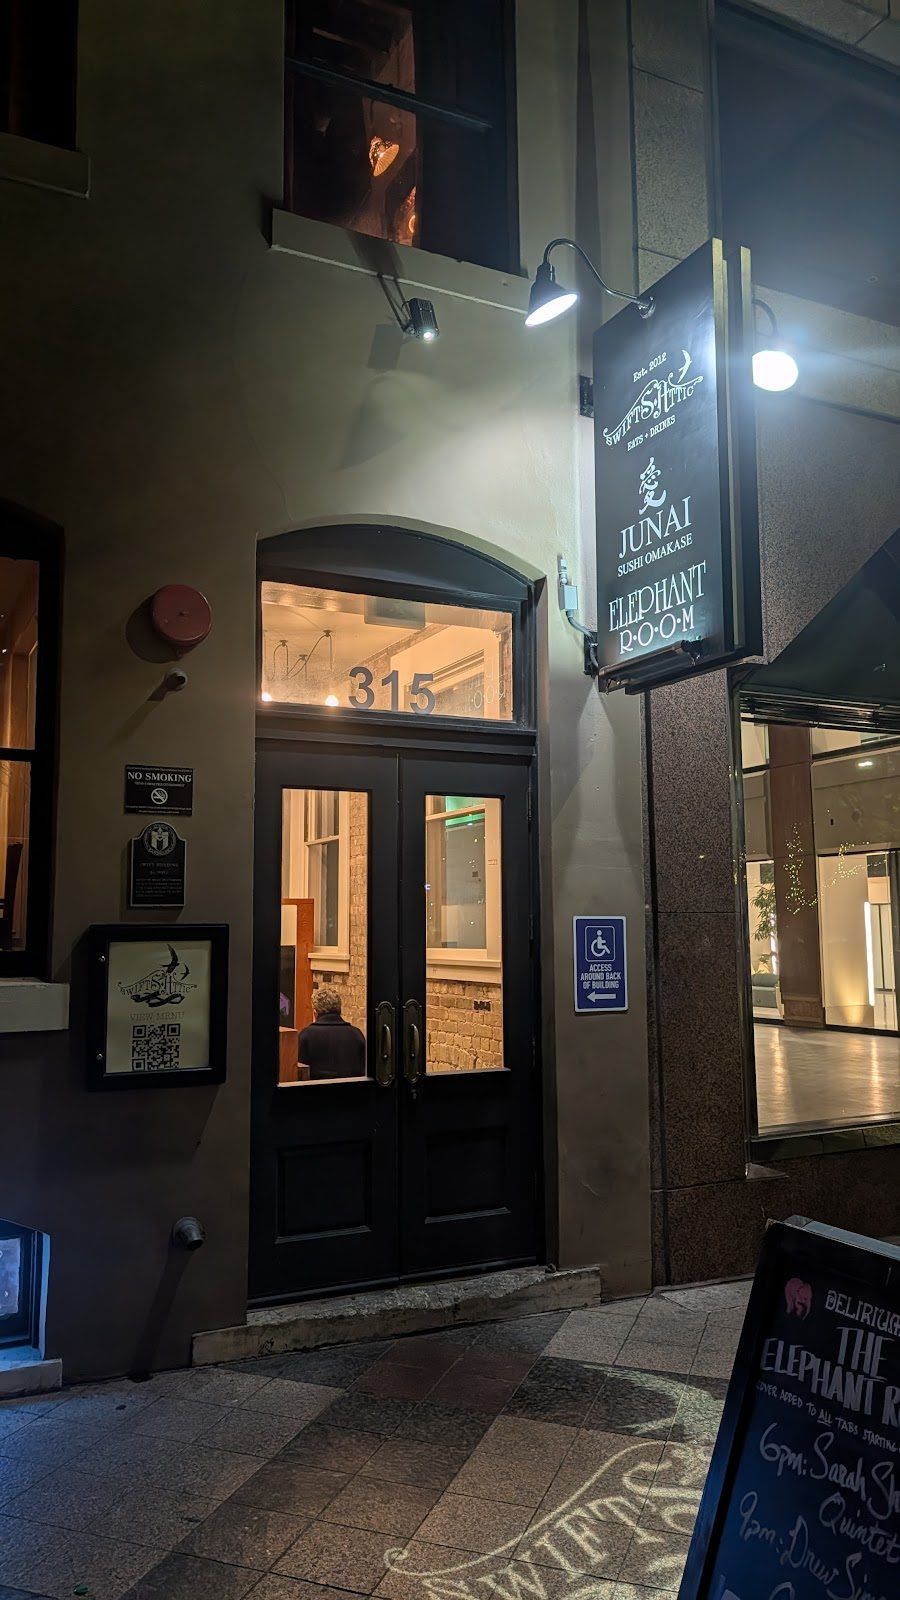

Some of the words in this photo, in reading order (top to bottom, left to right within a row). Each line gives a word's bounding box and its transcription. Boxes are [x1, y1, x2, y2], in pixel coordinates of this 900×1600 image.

[633, 367, 648, 382] Est.
[649, 352, 667, 371] 2012
[627, 434, 644, 451] EATS
[650, 415, 676, 438] DRINKS
[618, 495, 692, 559] JUNAI
[617, 556, 643, 577] SUSHI
[645, 533, 693, 564] OMAKASE
[608, 560, 707, 632] ELEPHANT
[348, 666, 436, 714] 315
[127, 771, 143, 780] NO
[145, 773, 192, 783] SMOKING
[580, 972, 604, 981] AROUND
[605, 972, 621, 980] BACK
[582, 981, 591, 990] OF
[592, 980, 619, 989] BUILDING
[589, 963, 612, 972] ACCESS
[129, 1012, 154, 1021] VIEW
[155, 1011, 185, 1021] MENU
[835, 1326, 895, 1381] THE
[760, 1337, 888, 1416] ELEPHANT
[780, 1389, 803, 1408] ADDED
[805, 1402, 817, 1416] TO
[817, 1409, 832, 1426] ALL
[835, 1416, 858, 1435] TABS
[863, 1429, 897, 1452] STARTING
